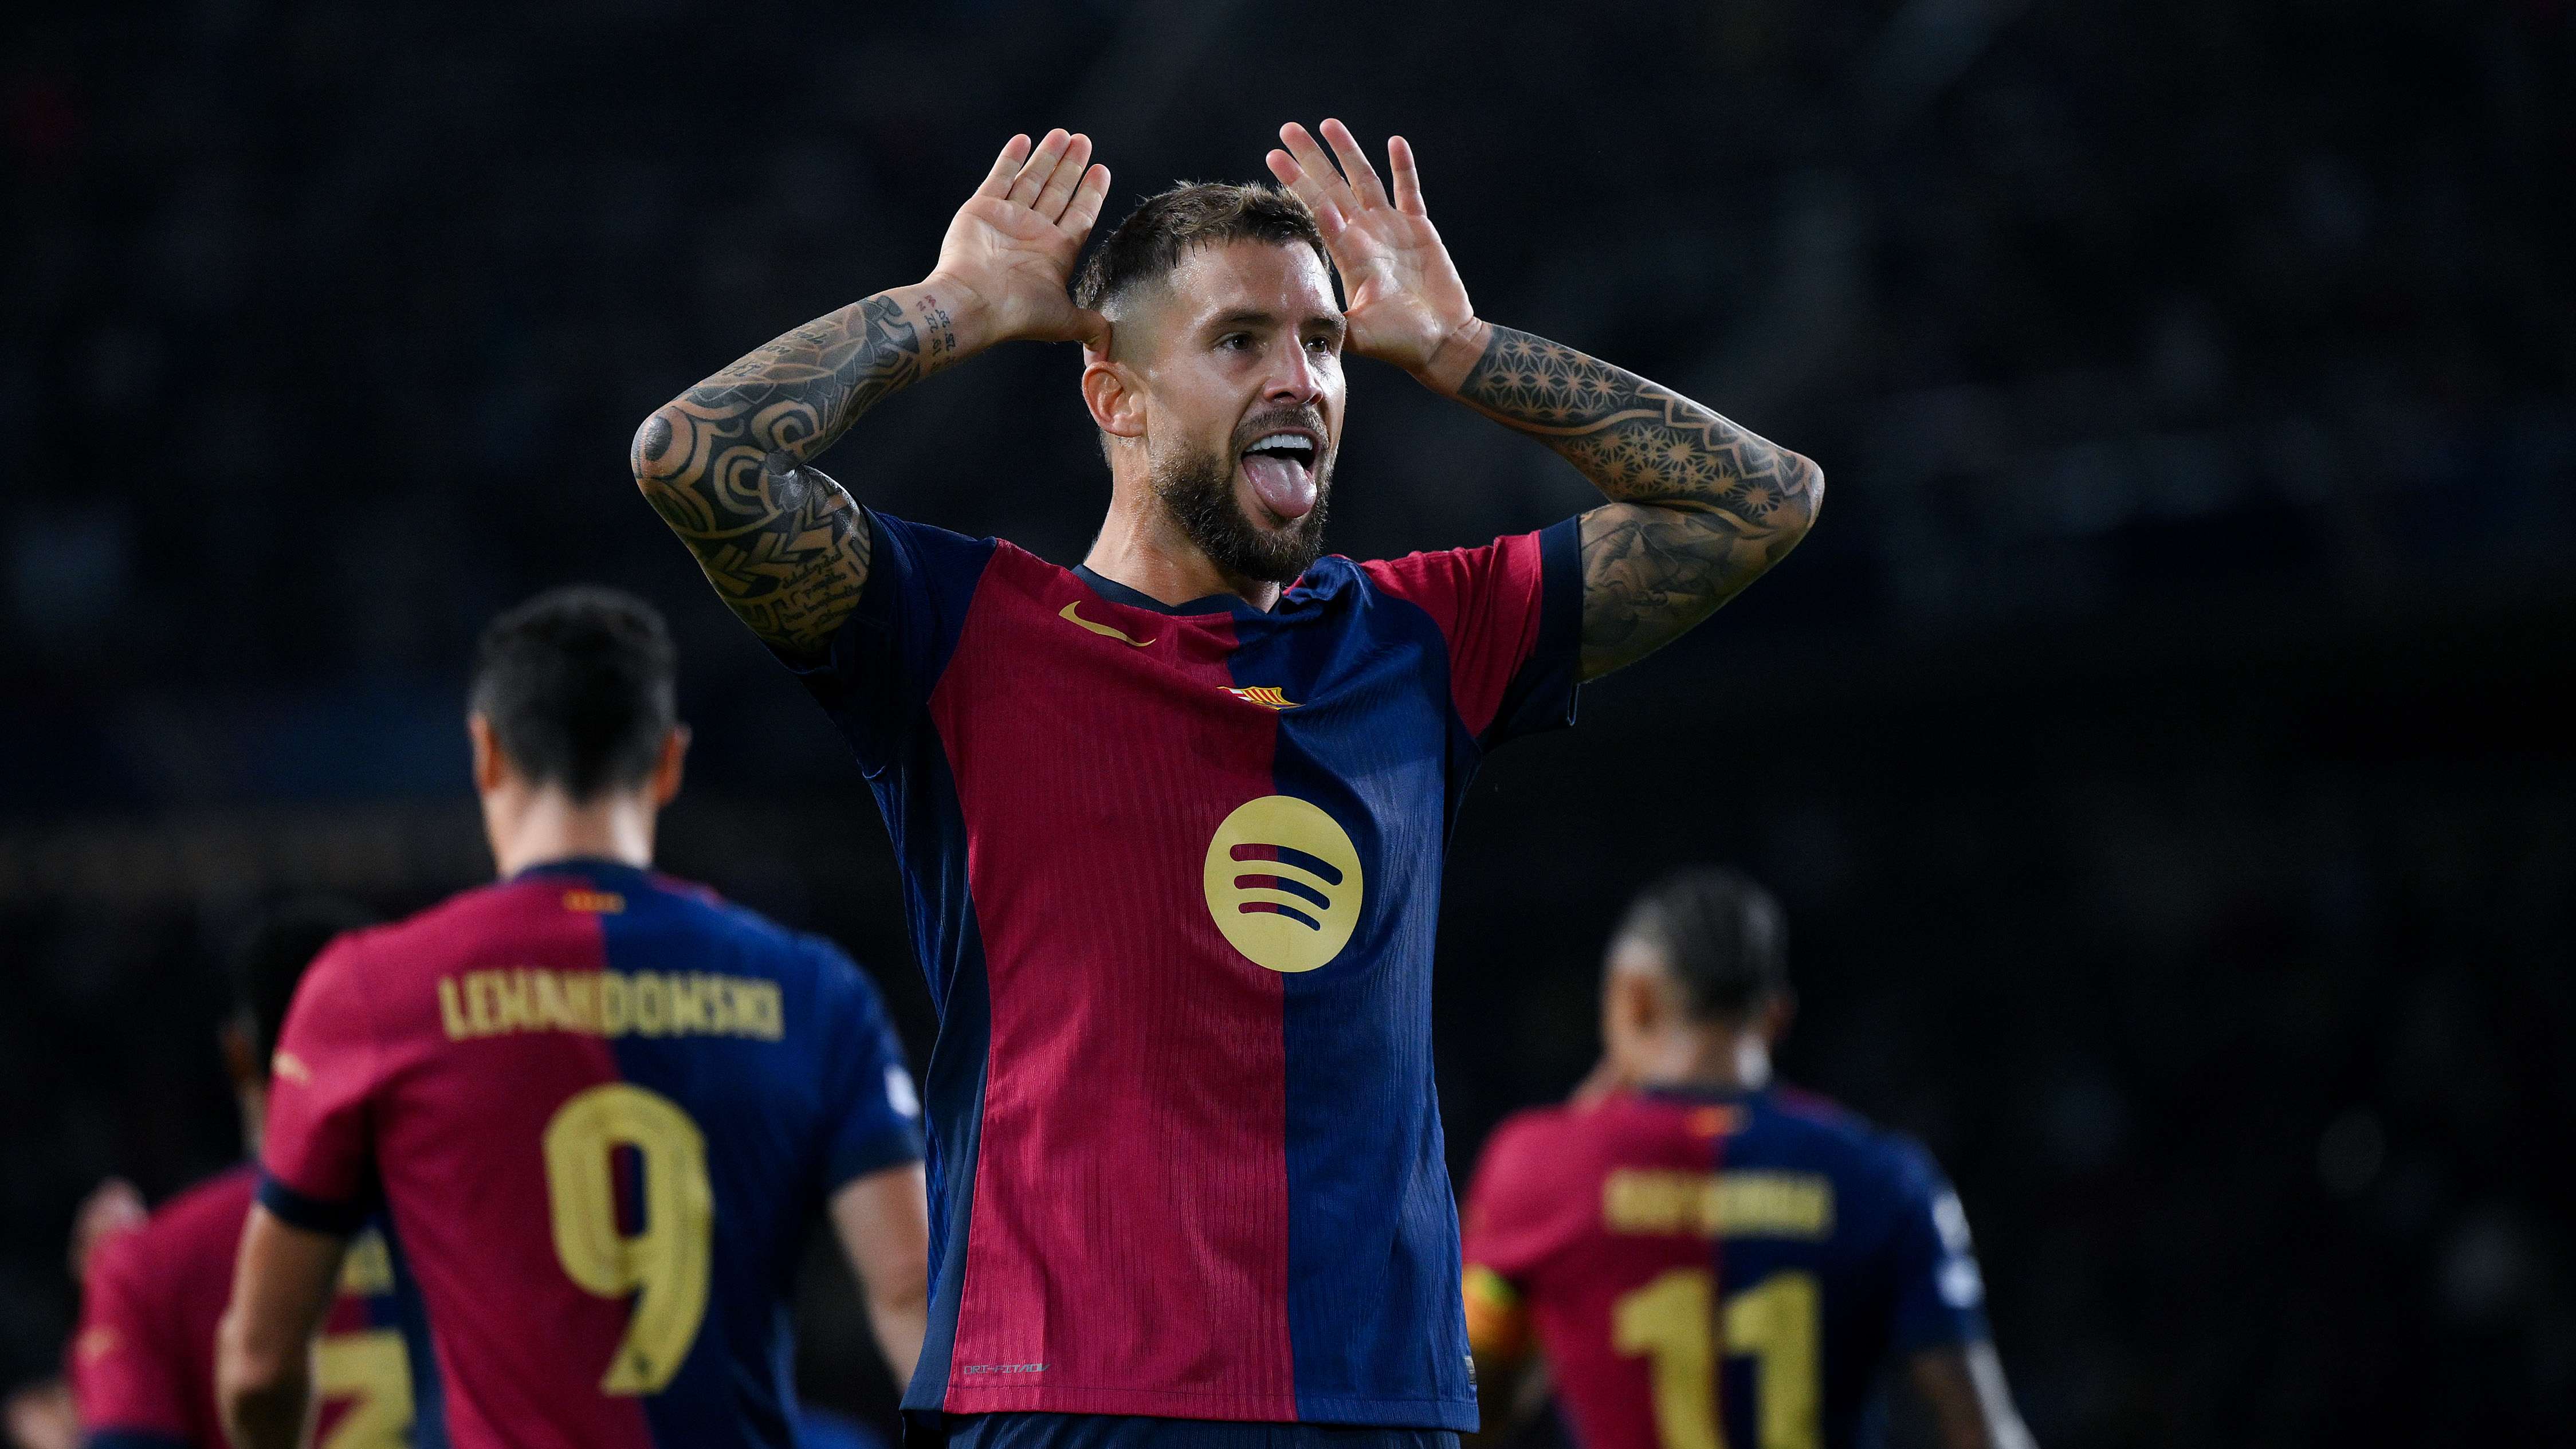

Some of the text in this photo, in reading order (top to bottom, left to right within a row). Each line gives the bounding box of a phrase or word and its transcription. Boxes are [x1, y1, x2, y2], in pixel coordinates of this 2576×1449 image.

[439, 969, 783, 1040] LEWANDOWSKI
[541, 1082, 713, 1397] 9
[1611, 1267, 1825, 1449] 11
